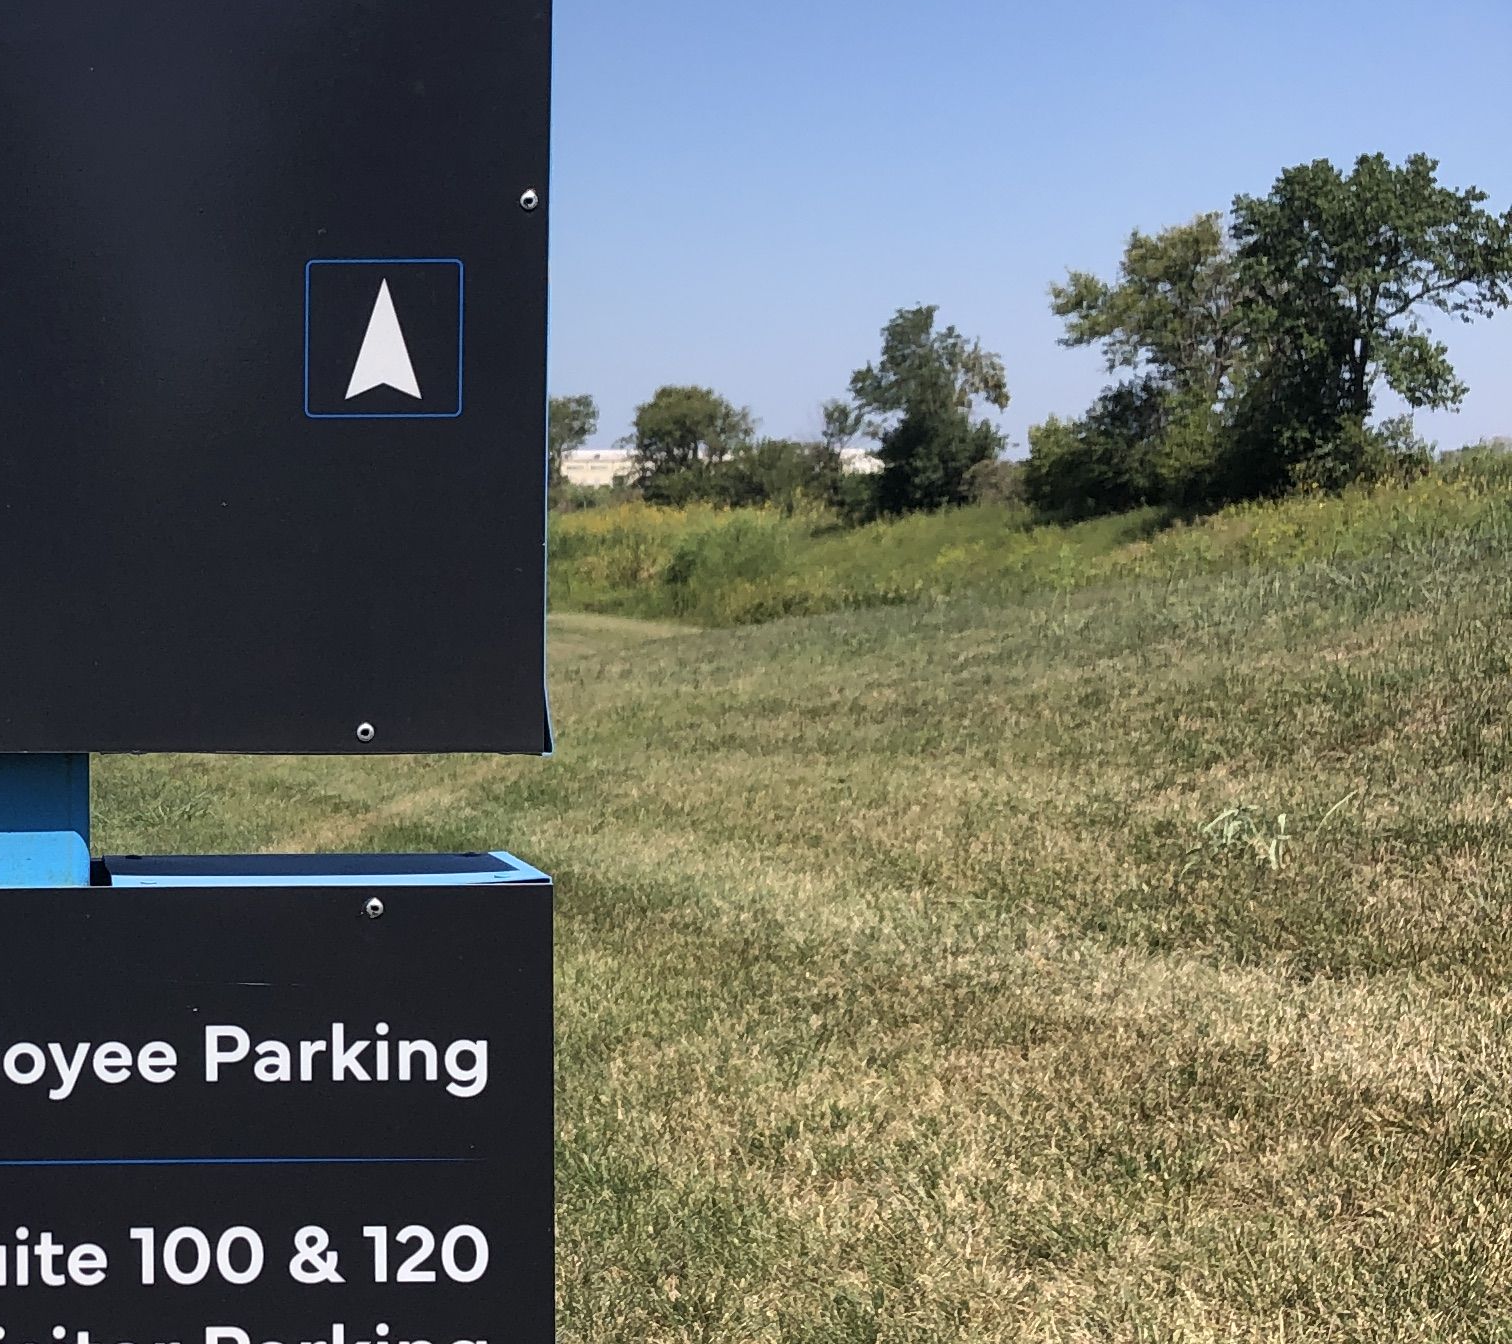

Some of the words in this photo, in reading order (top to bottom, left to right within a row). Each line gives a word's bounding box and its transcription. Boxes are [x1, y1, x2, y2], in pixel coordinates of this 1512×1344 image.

[205, 1021, 488, 1098] Parking
[129, 1225, 264, 1285] 100
[289, 1225, 346, 1284] &
[362, 1224, 489, 1283] 120
